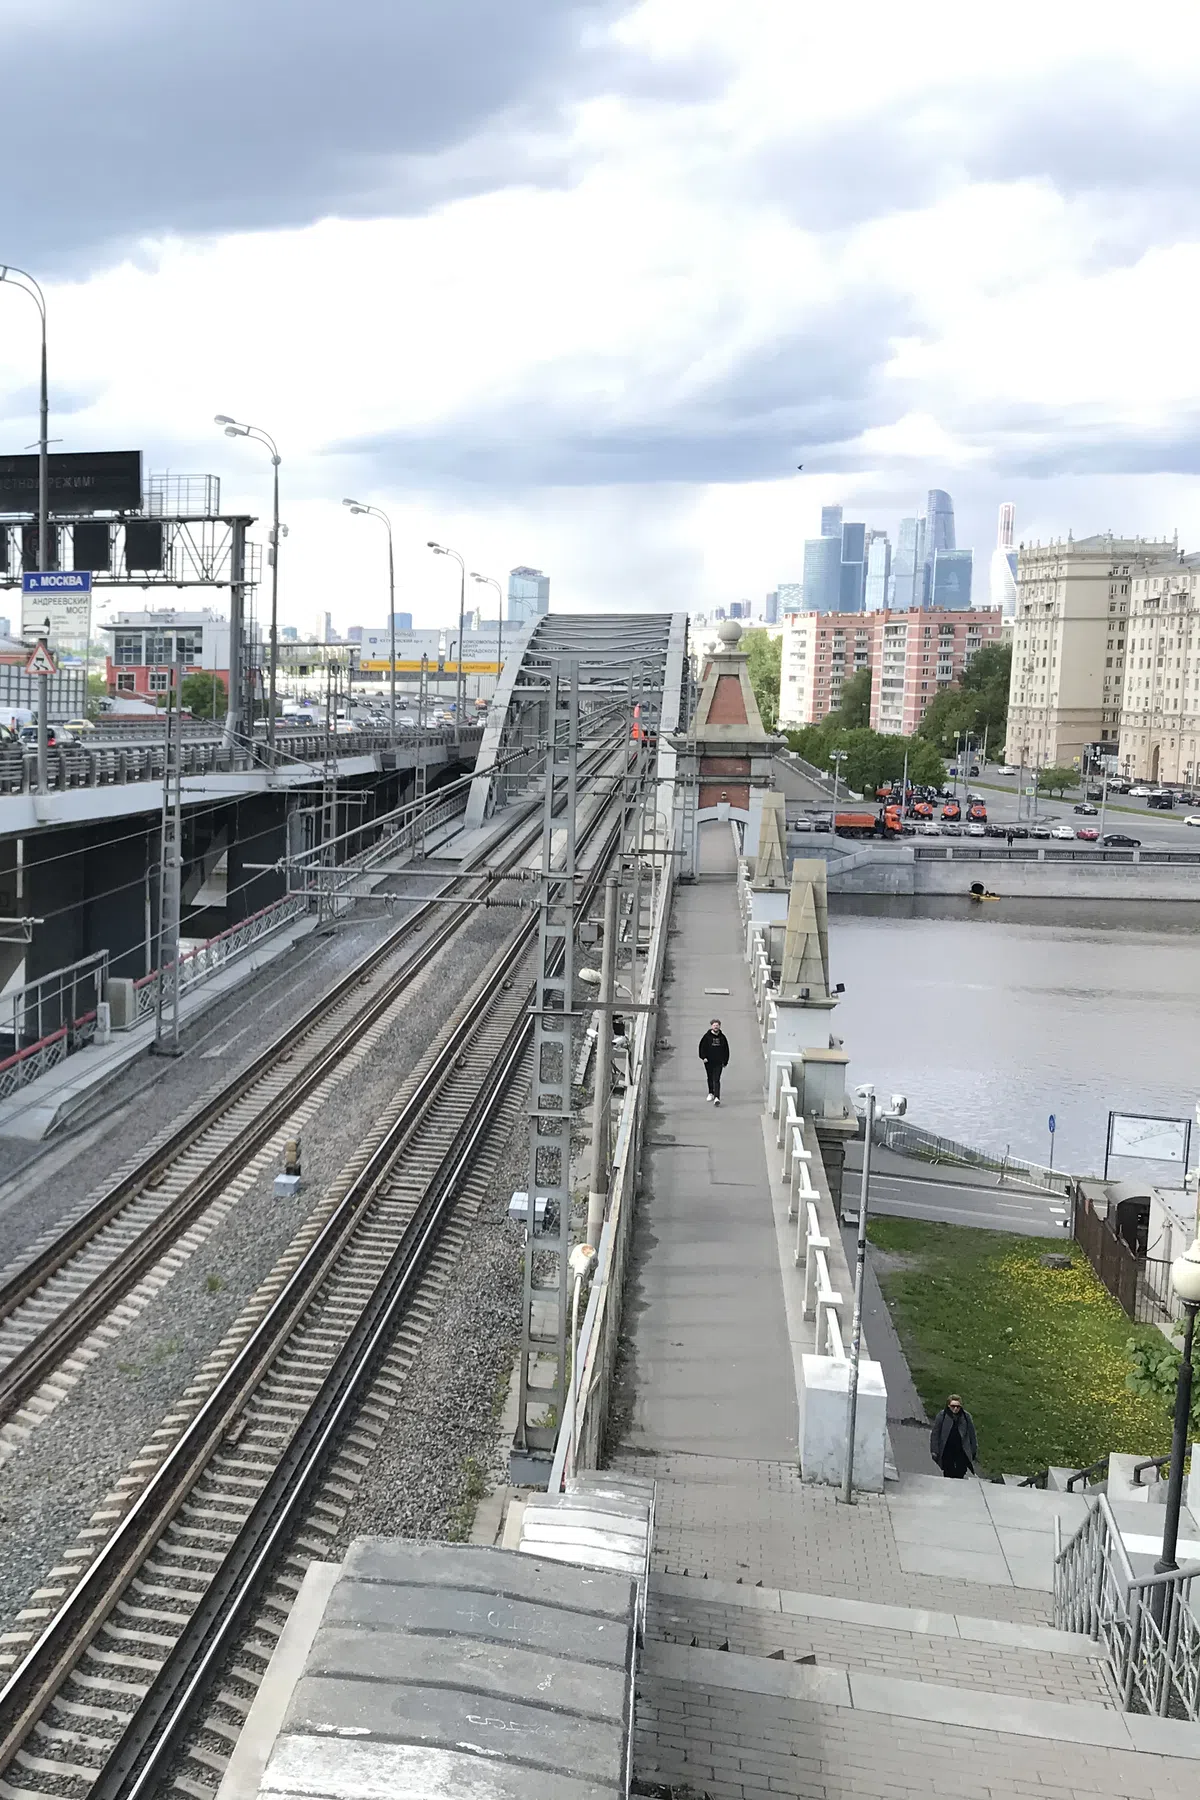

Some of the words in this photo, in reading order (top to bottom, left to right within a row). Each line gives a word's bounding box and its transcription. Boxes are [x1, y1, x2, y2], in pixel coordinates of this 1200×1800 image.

[29, 578, 39, 589] р.
[40, 575, 83, 587] МОСКВА
[32, 597, 88, 606] АНДРЕЕВСКИЙ
[66, 606, 88, 614] МОСТ
